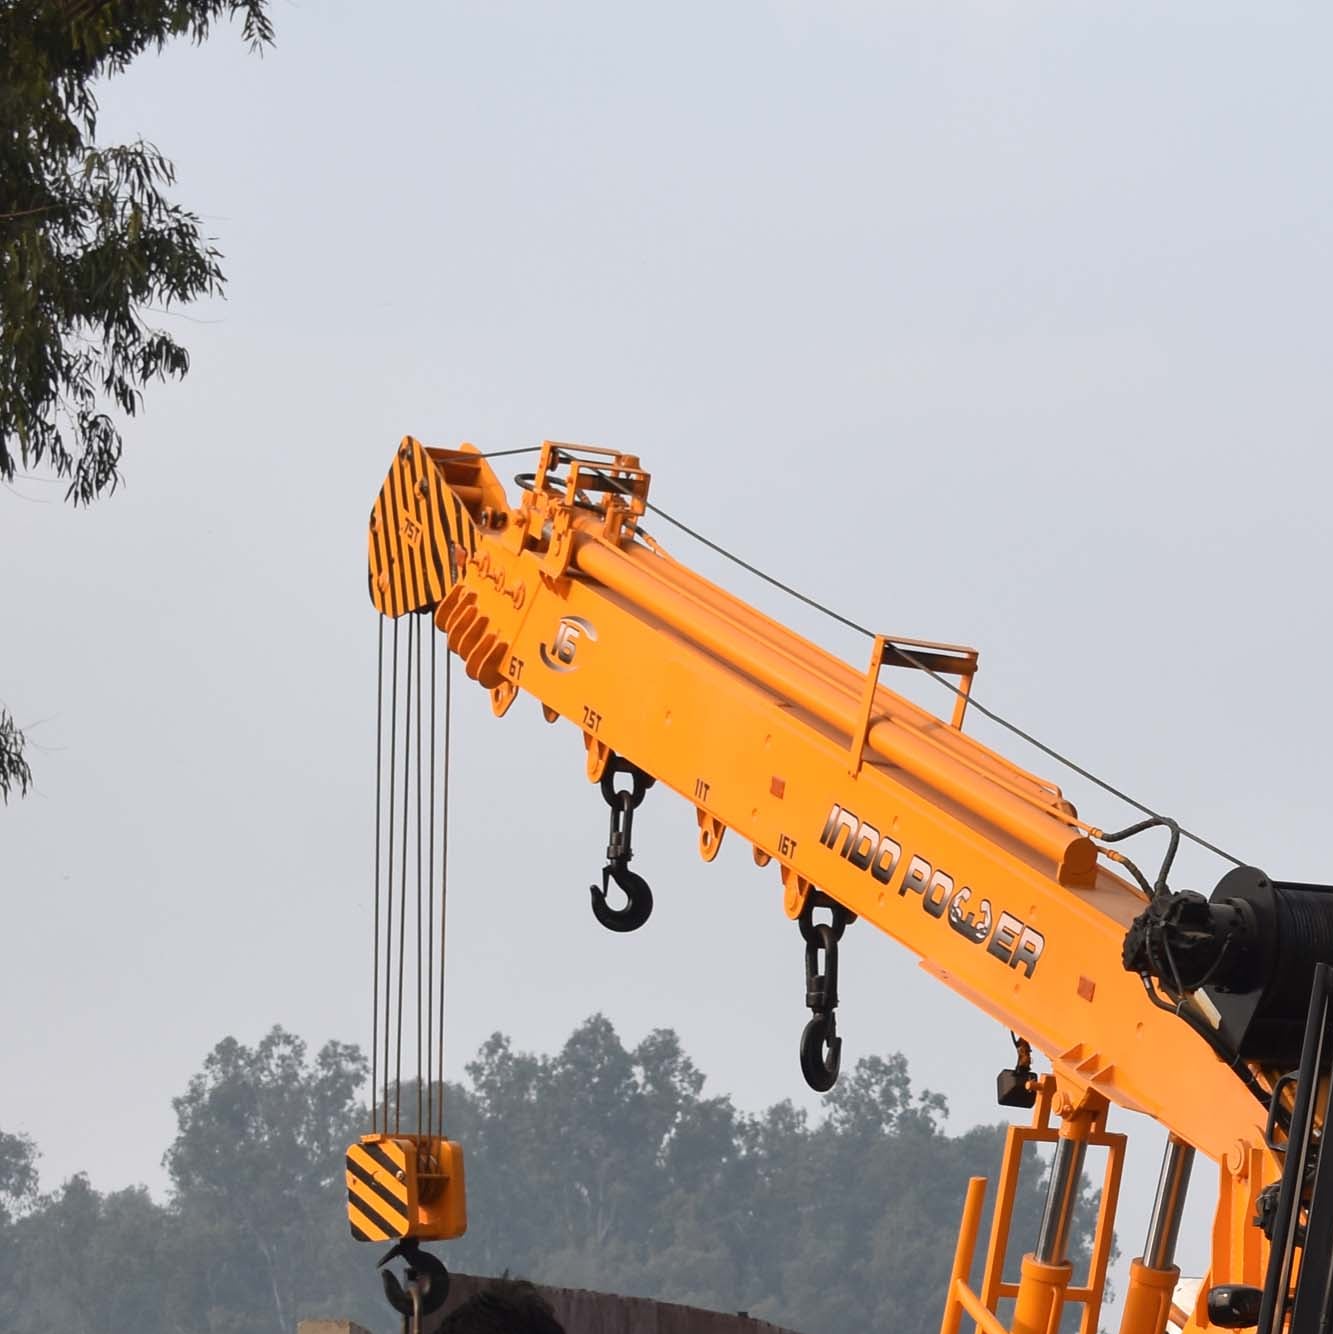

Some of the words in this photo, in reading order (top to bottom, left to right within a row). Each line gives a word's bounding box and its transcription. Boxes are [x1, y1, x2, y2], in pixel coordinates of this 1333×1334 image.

[550, 620, 581, 666] 16
[508, 655, 525, 681] 6T
[777, 832, 798, 860] 16T
[819, 802, 903, 886] INDO
[897, 853, 1046, 980] POWER
